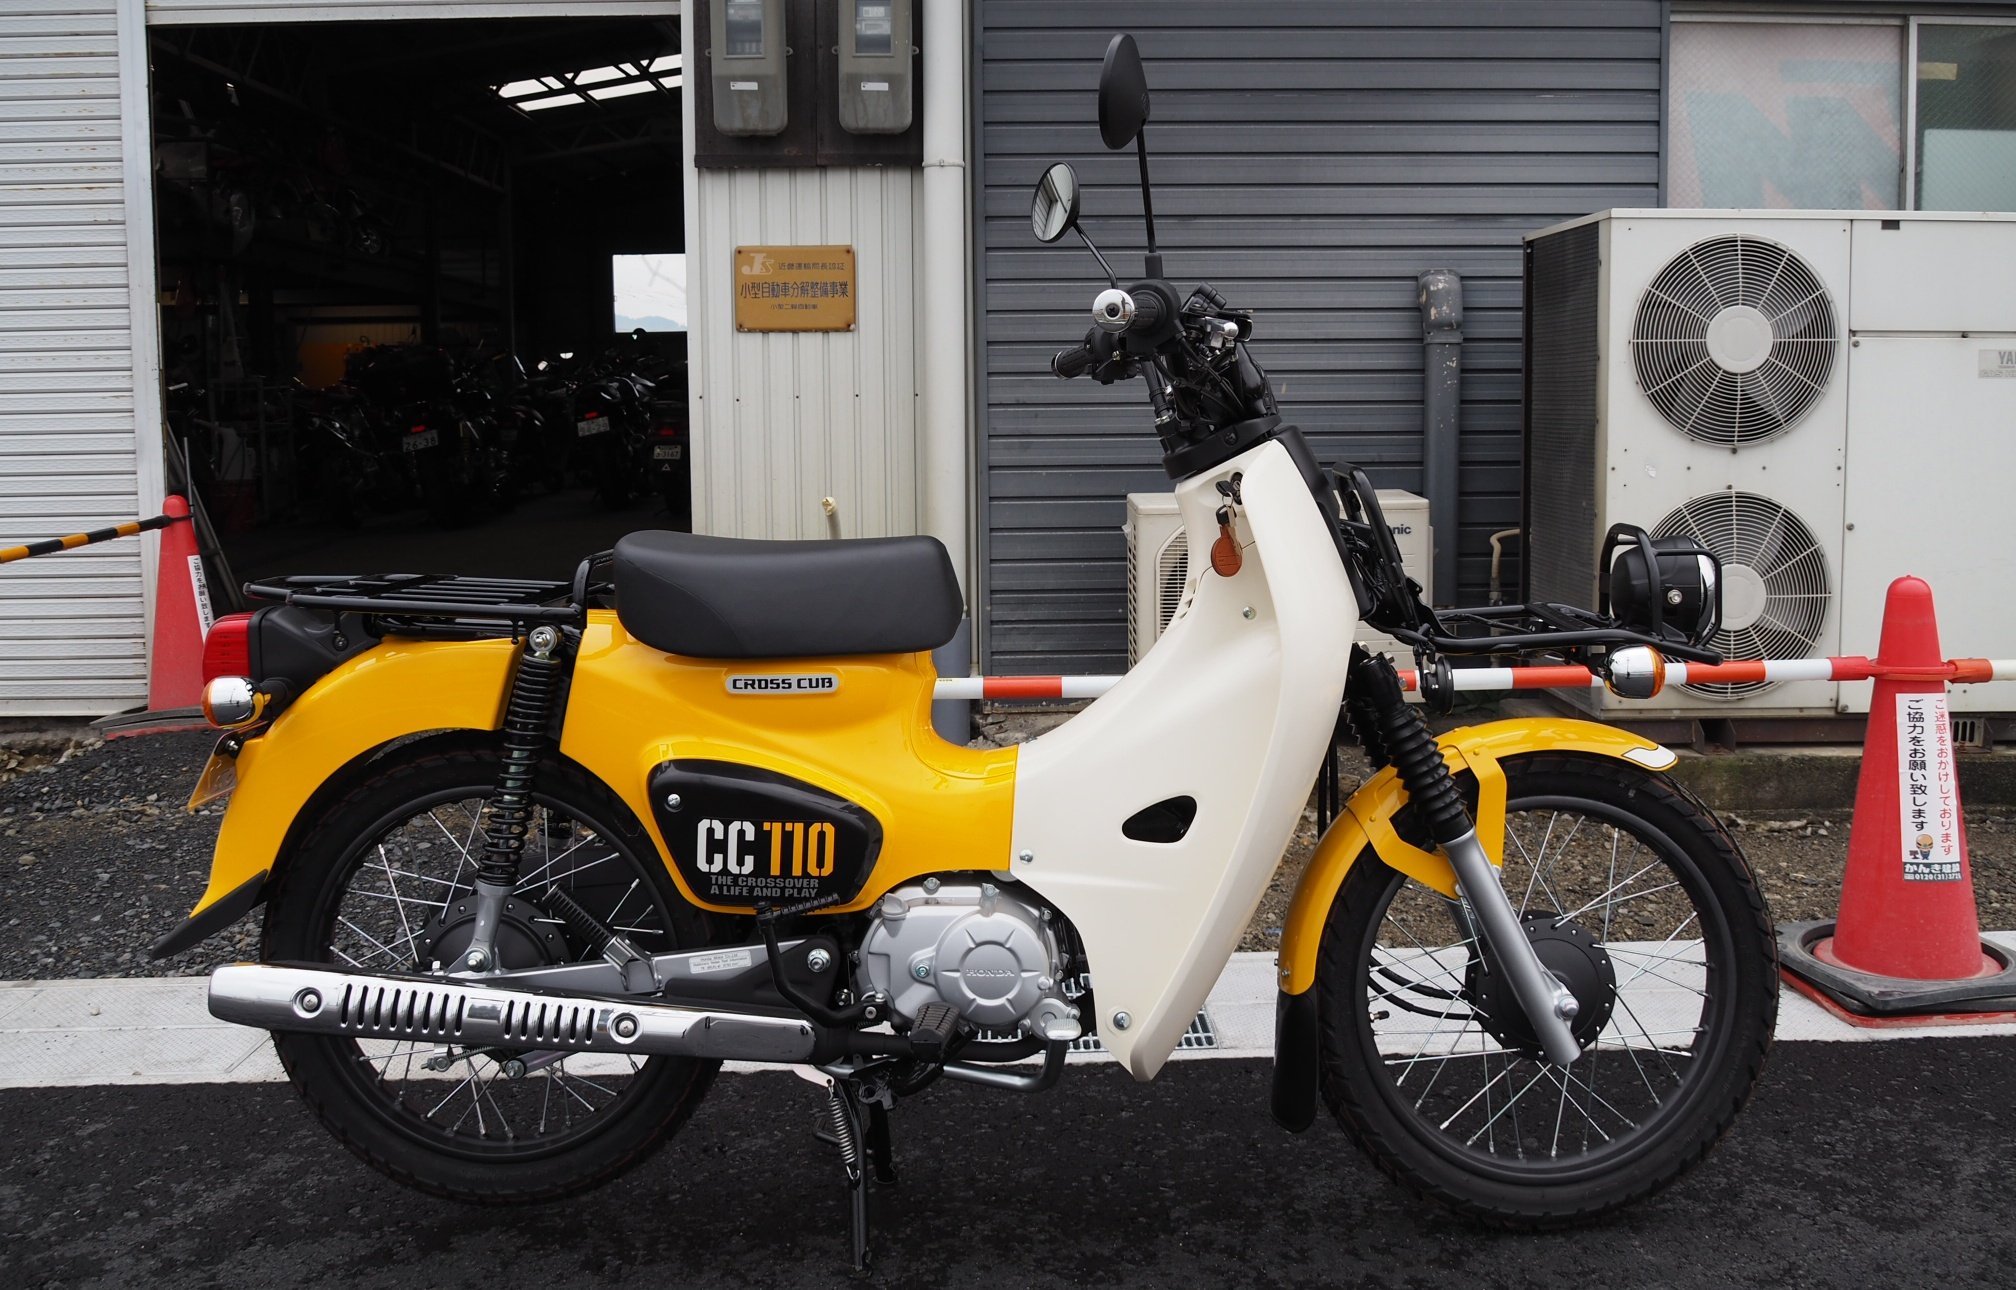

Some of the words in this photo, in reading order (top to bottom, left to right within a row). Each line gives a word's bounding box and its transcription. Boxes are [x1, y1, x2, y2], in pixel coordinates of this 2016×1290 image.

[741, 281, 849, 298] 小型自動車分解整備事業
[1998, 352, 2016, 364] YA
[732, 678, 793, 690] CROSS
[796, 678, 833, 689] CUB
[1907, 698, 1928, 832] ご協力をお願い致します
[1935, 698, 1954, 856] ご迷惑をおかけしております
[697, 818, 756, 875] CC
[763, 822, 835, 877] 110
[711, 875, 734, 885] THE
[738, 876, 819, 888] CROSSOVER
[710, 886, 719, 895] A
[722, 886, 749, 896] LIFE
[753, 887, 780, 897] AND
[784, 888, 818, 898] PLAY
[966, 968, 1015, 977] HONDA
